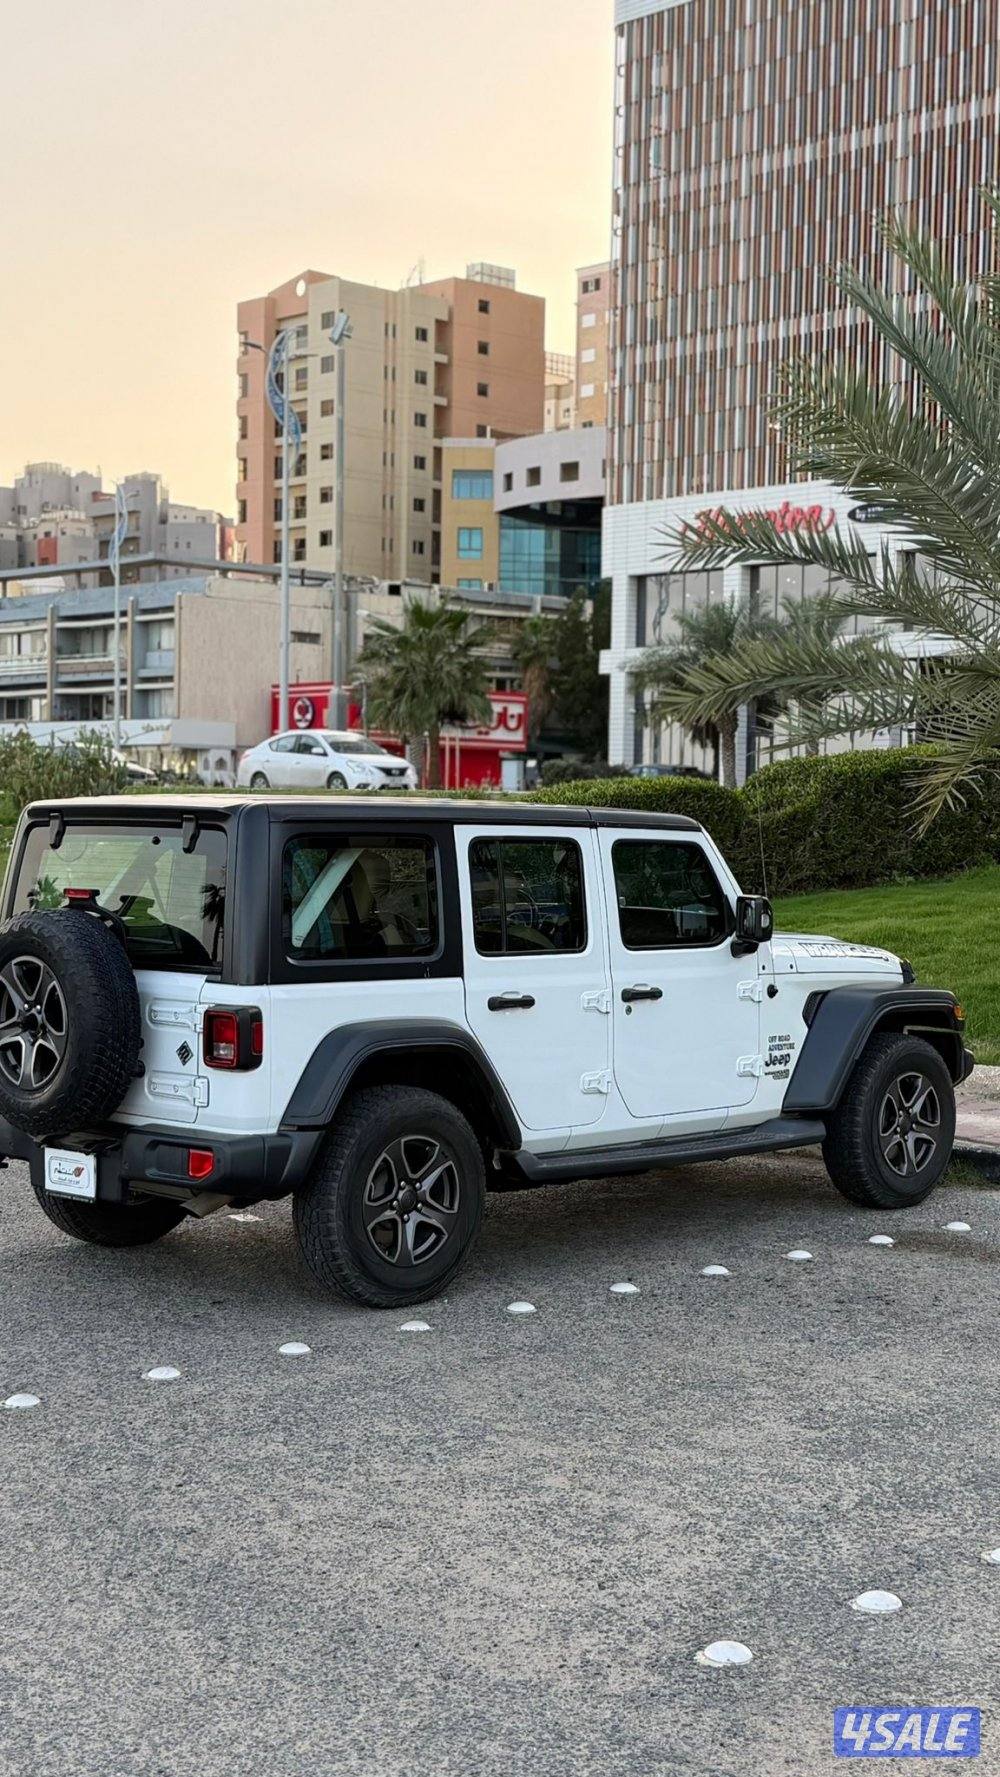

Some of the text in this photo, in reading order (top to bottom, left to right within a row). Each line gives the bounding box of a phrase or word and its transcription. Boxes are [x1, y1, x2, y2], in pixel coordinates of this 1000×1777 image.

[768, 1034, 791, 1043] OFF ROAD
[768, 1043, 795, 1051] ADVENTURE
[764, 1053, 791, 1067] Jeep
